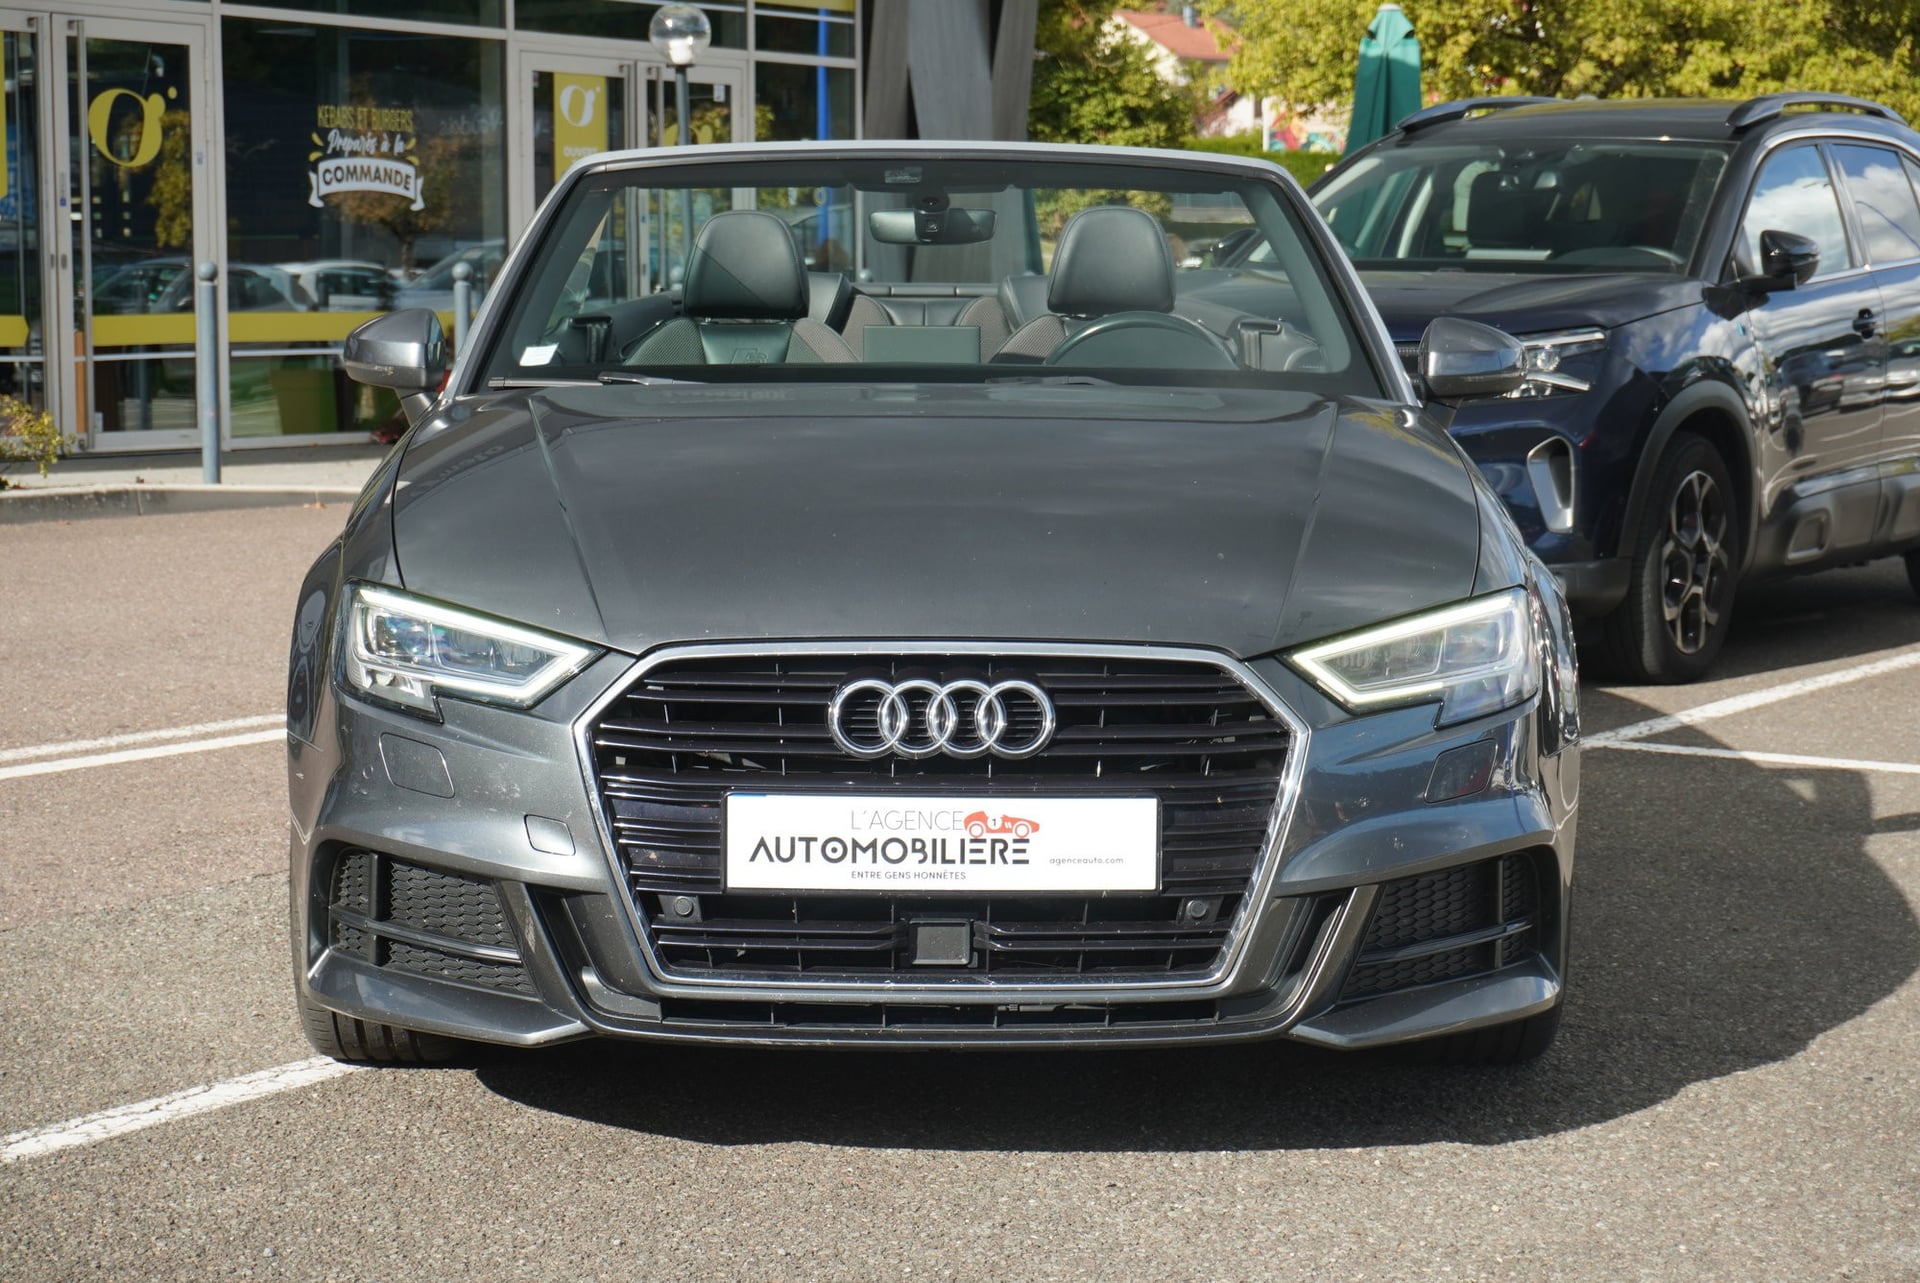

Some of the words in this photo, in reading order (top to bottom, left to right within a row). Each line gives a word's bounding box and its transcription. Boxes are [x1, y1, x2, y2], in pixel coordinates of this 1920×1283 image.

[318, 105, 354, 129] KEBABS
[357, 107, 368, 130] ET
[371, 109, 413, 133] BURGERS
[322, 165, 411, 190] COMMANDE
[851, 810, 963, 830] L'AGENCE
[1049, 857, 1124, 866] agenceauto.com
[851, 871, 880, 879] ENTRE
[885, 871, 910, 879] GENS
[914, 868, 965, 880] HONNÊTES
